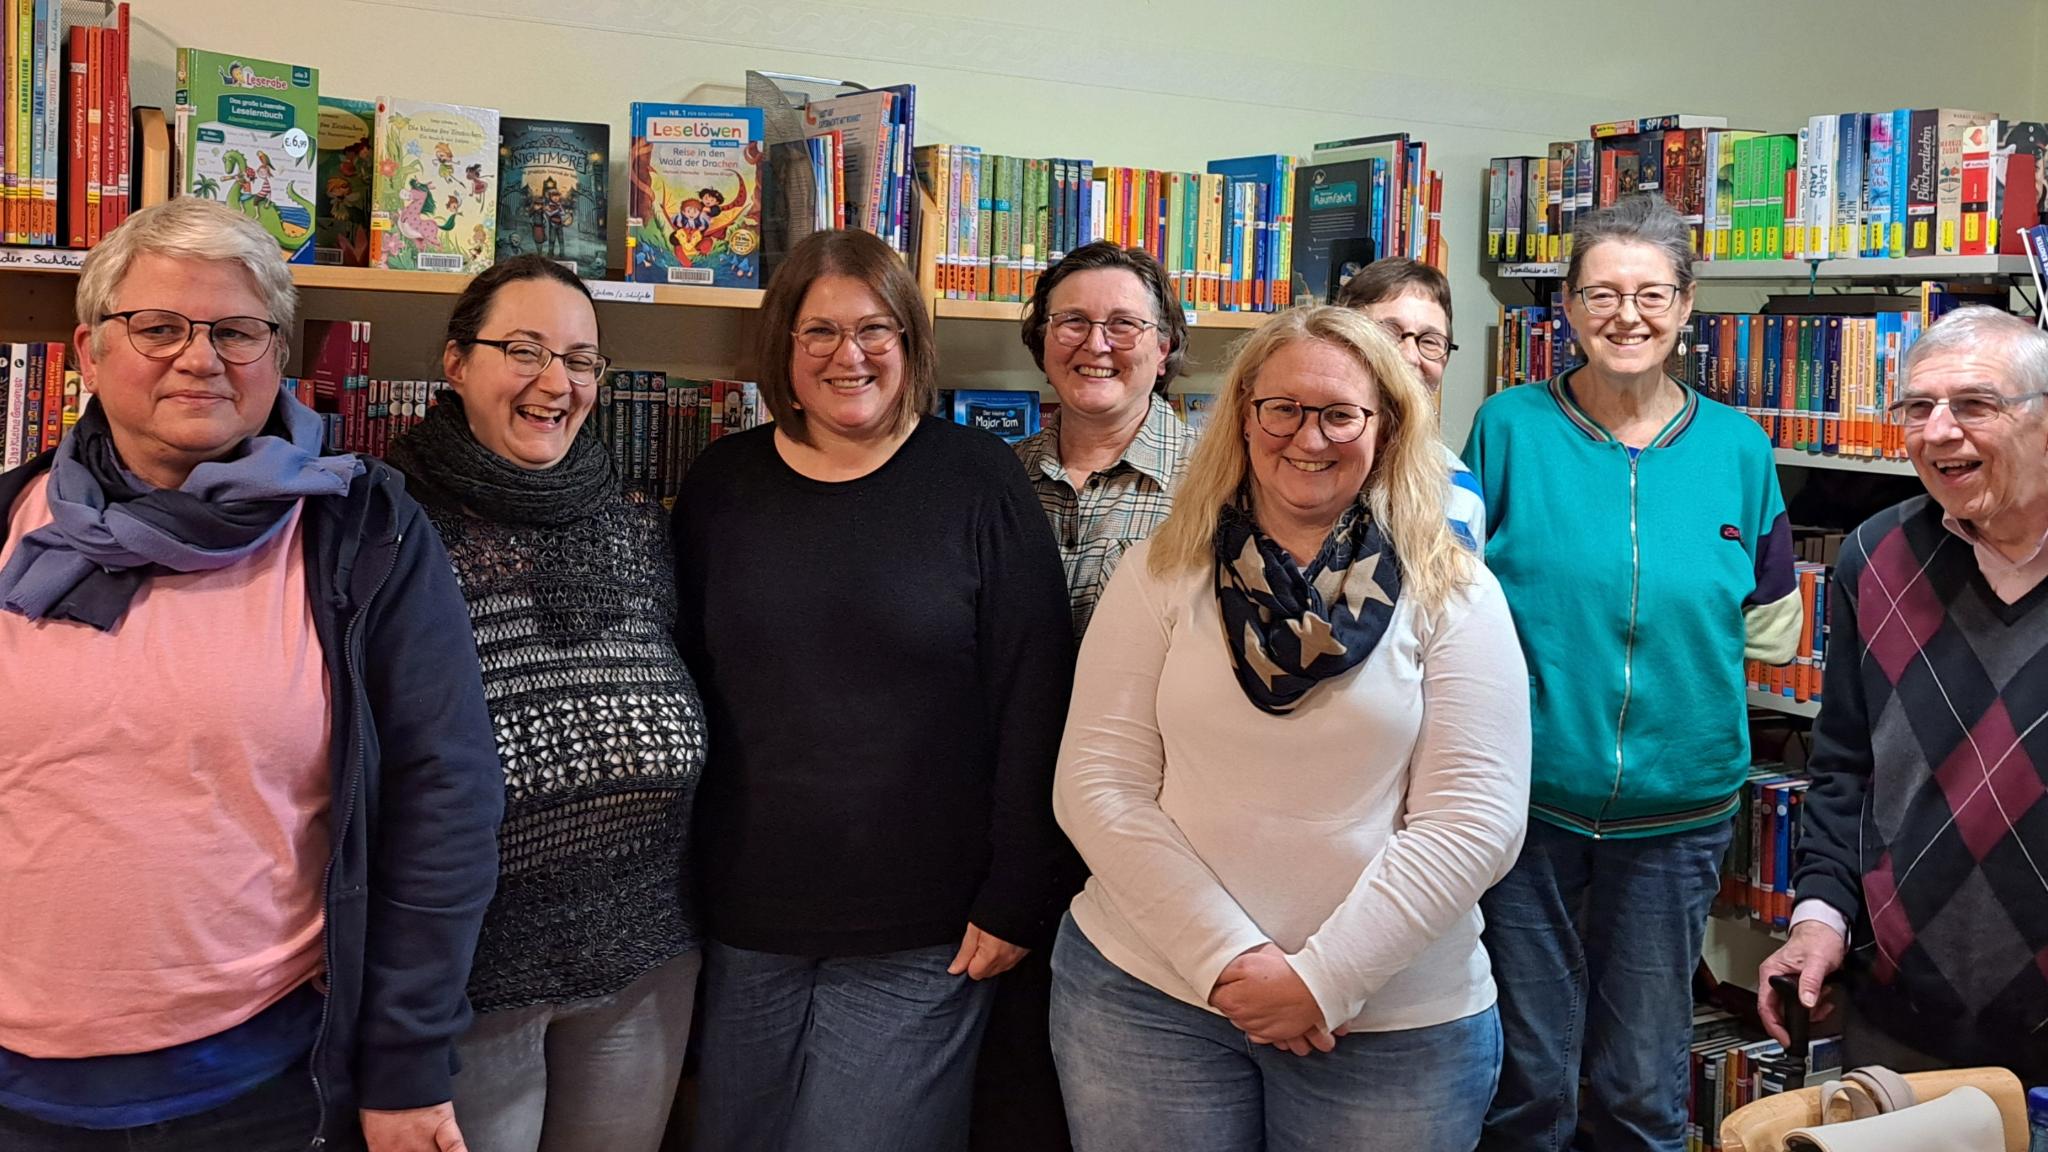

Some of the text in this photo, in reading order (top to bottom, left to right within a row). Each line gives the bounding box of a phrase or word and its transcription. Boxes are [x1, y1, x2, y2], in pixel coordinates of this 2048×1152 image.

[21, 58, 29, 113] KRABBELTIERE
[246, 72, 288, 90] Leserabe
[35, 90, 44, 115] HAIE
[229, 97, 287, 112] Das große Leserabe
[231, 105, 284, 120] Leselernbuch
[653, 122, 742, 138] Leselöwen
[512, 151, 585, 170] NIGHTMORE
[673, 148, 726, 158] Reise in den
[1800, 156, 1808, 168] für
[659, 158, 739, 169] Wald der Drachen
[872, 140, 885, 201] EXPERIMENTE MIT
[1917, 125, 1932, 201] Bücherdiebin
[1809, 165, 1818, 199] LAND
[1910, 177, 1919, 192] Die
[1314, 192, 1353, 206] Raumfahrt
[1838, 191, 1847, 213] OHNE
[1846, 200, 1856, 225] NICHT
[0, 252, 23, 263] der
[1800, 360, 1809, 399] Zauberkugel
[1828, 360, 1839, 400] Zauberkugel
[976, 416, 1019, 430] Major Tom
[7, 446, 19, 465] Das
[634, 438, 642, 463] KLEINE
[650, 438, 658, 464] KLEINE
